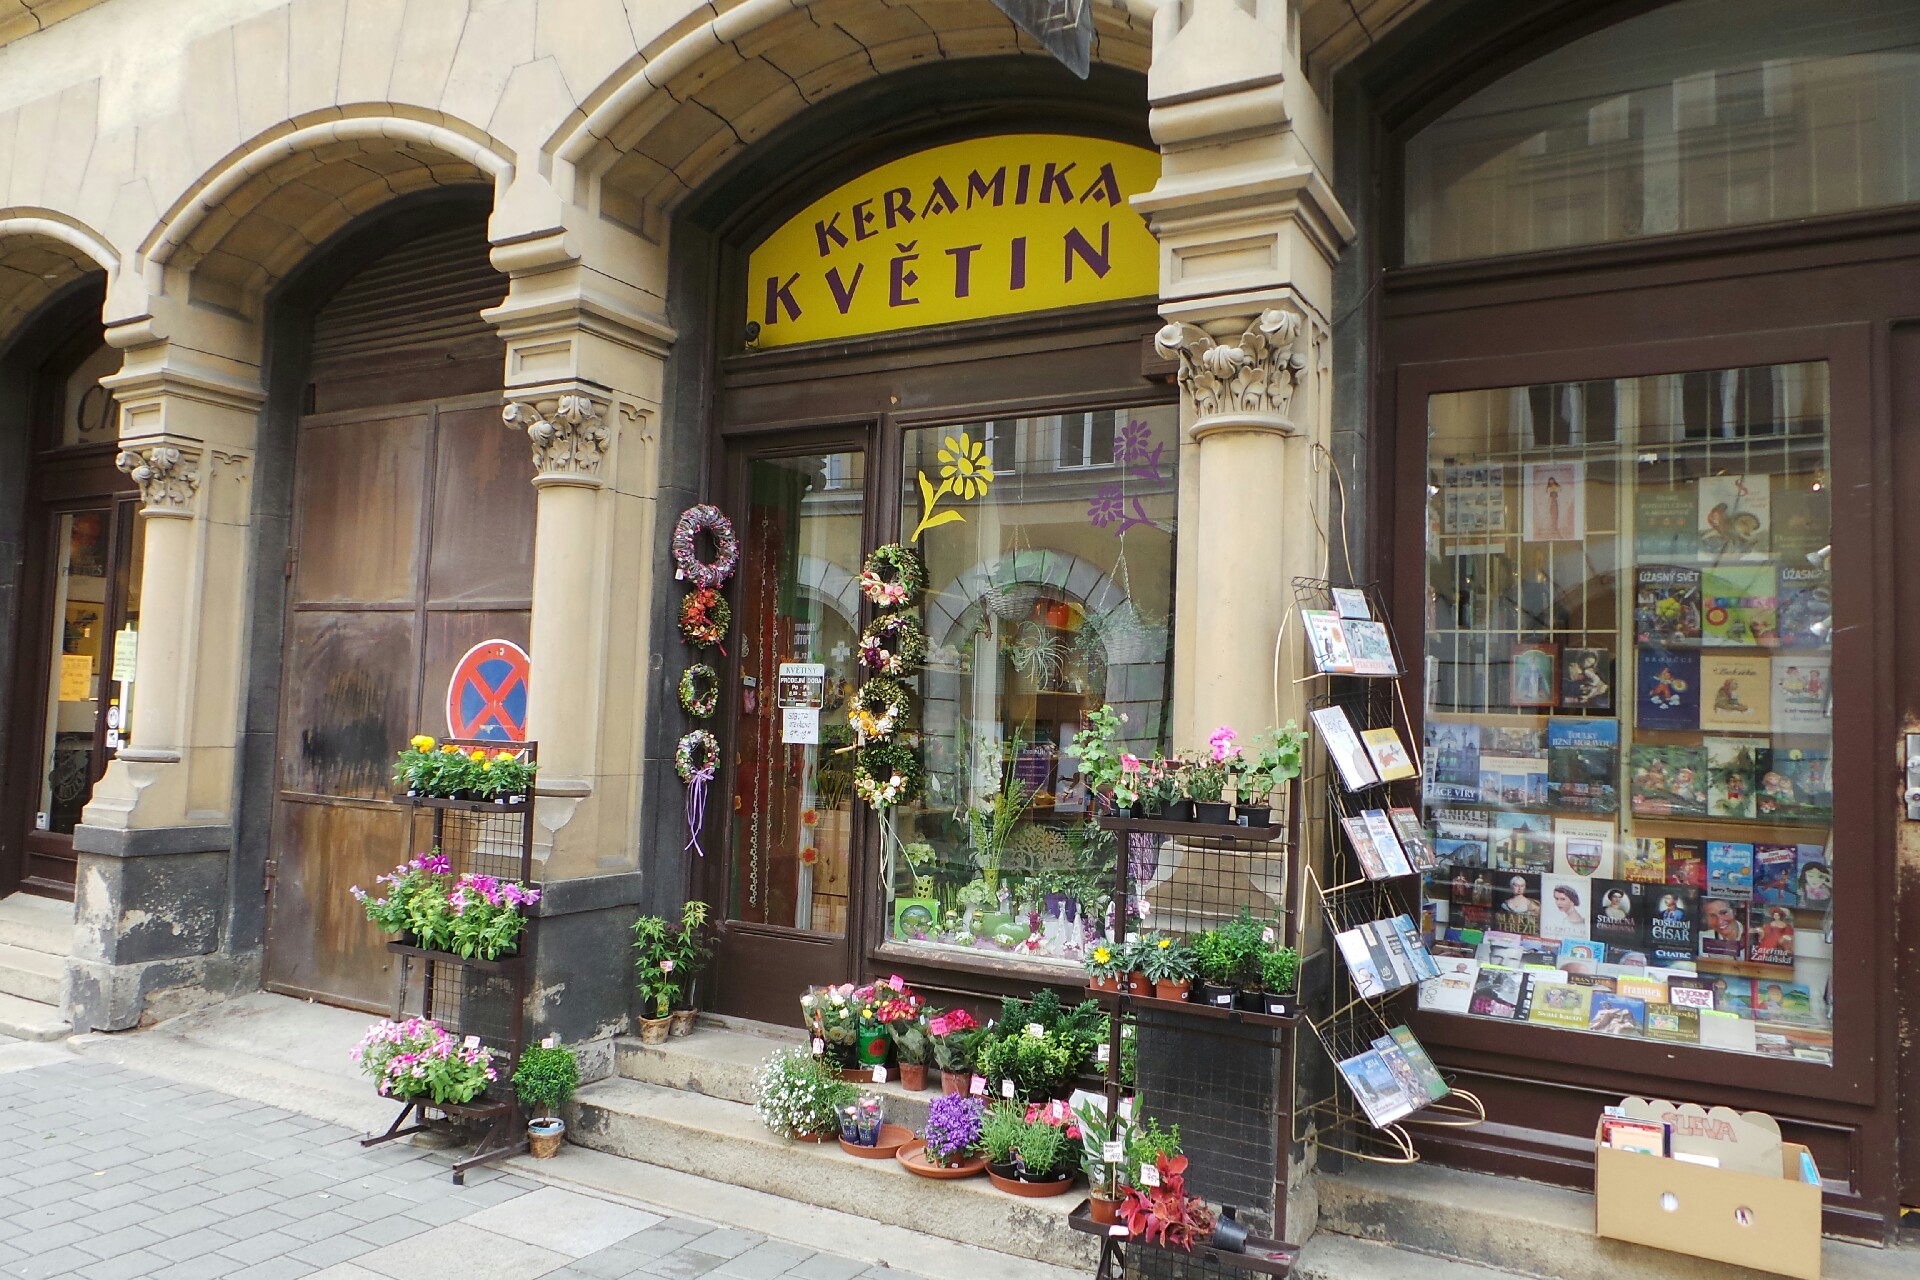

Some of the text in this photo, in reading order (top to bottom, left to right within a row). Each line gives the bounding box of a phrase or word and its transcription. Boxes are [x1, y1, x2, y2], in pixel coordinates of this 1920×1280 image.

[815, 162, 1122, 257] KERAMIKA
[764, 220, 1112, 325] KVĚTIN
[786, 665, 817, 674] KVĚTINY
[1652, 917, 1691, 929] POSLEDNÍ
[1652, 925, 1690, 941] CÍSAŘ
[1623, 984, 1661, 997] František
[1661, 1111, 1738, 1143] SLEVA
